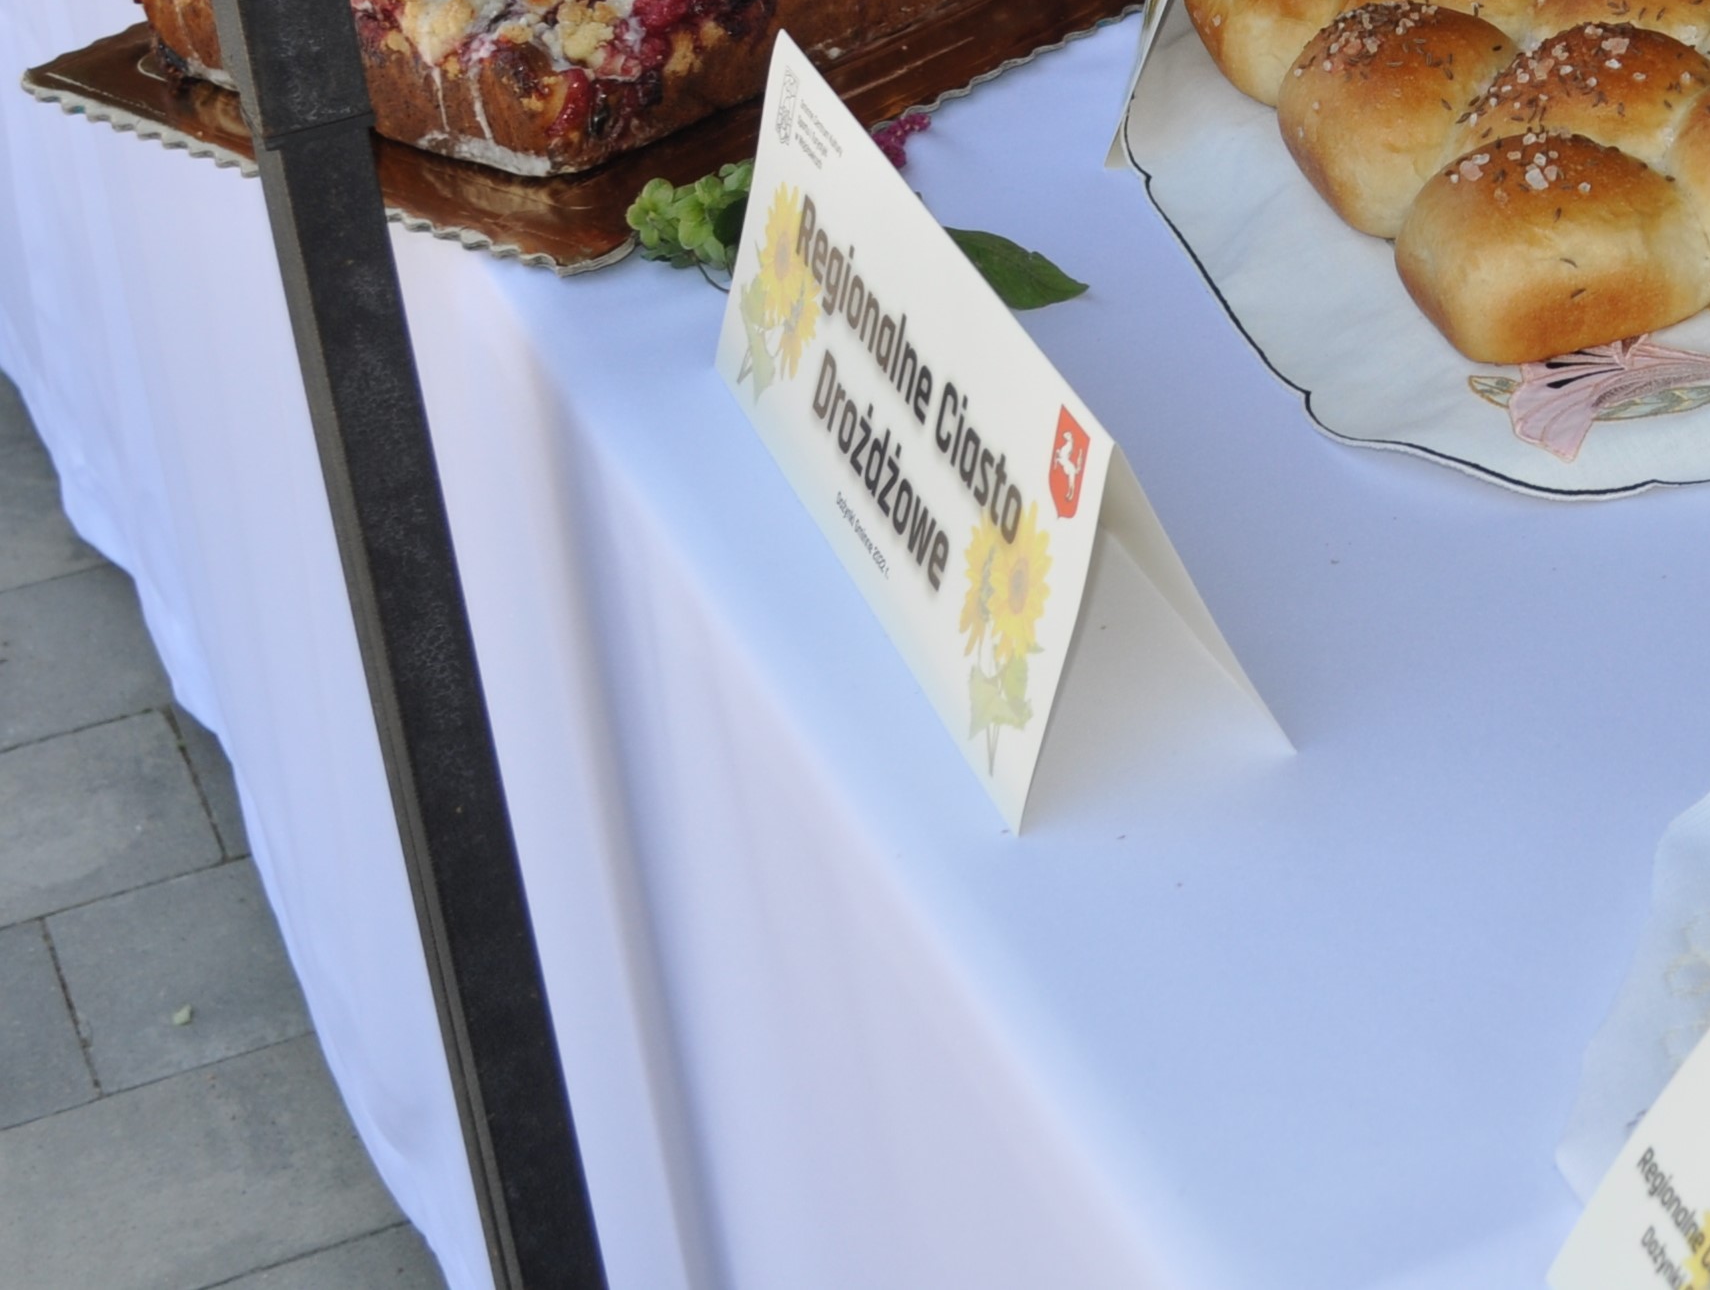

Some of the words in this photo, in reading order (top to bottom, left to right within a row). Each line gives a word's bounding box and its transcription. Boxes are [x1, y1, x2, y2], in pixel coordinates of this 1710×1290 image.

[796, 194, 933, 425] Regionalne
[935, 381, 1023, 545] Ciasto
[812, 348, 951, 592] Drożdżowe
[1636, 1147, 1706, 1255] Regionalne
